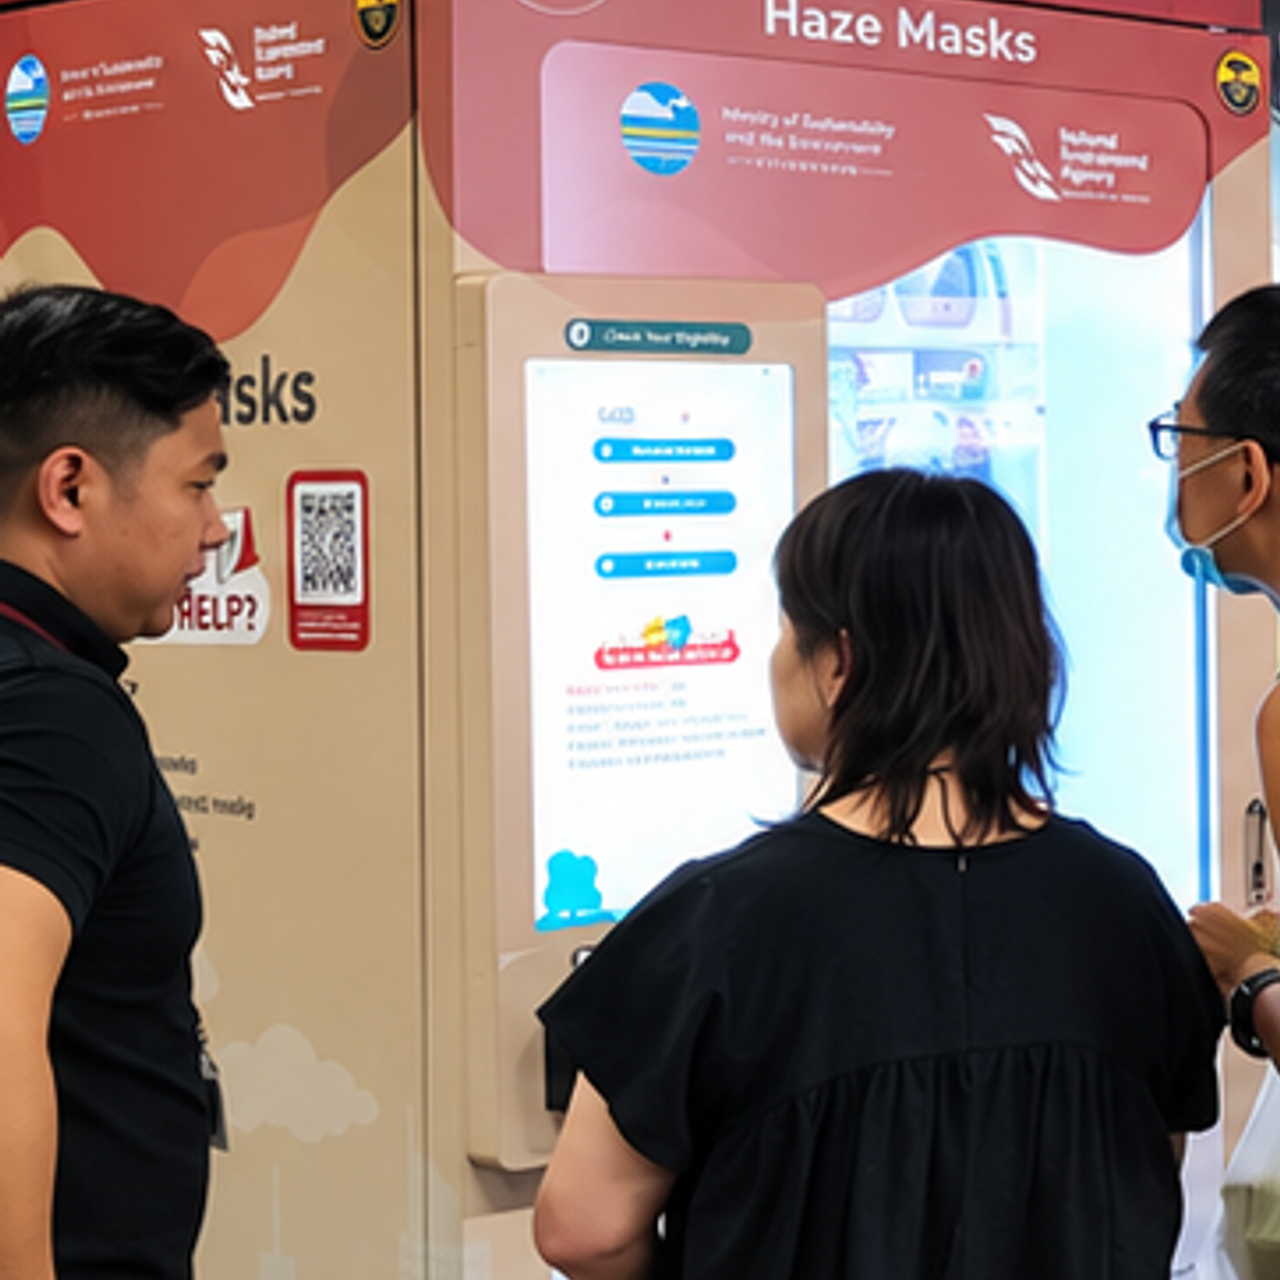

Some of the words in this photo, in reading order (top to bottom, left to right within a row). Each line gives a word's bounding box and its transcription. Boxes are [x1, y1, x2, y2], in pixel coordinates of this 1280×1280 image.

[897, 6, 1038, 64] Masks
[220, 354, 318, 425] sks
[177, 590, 258, 631] HELP?
